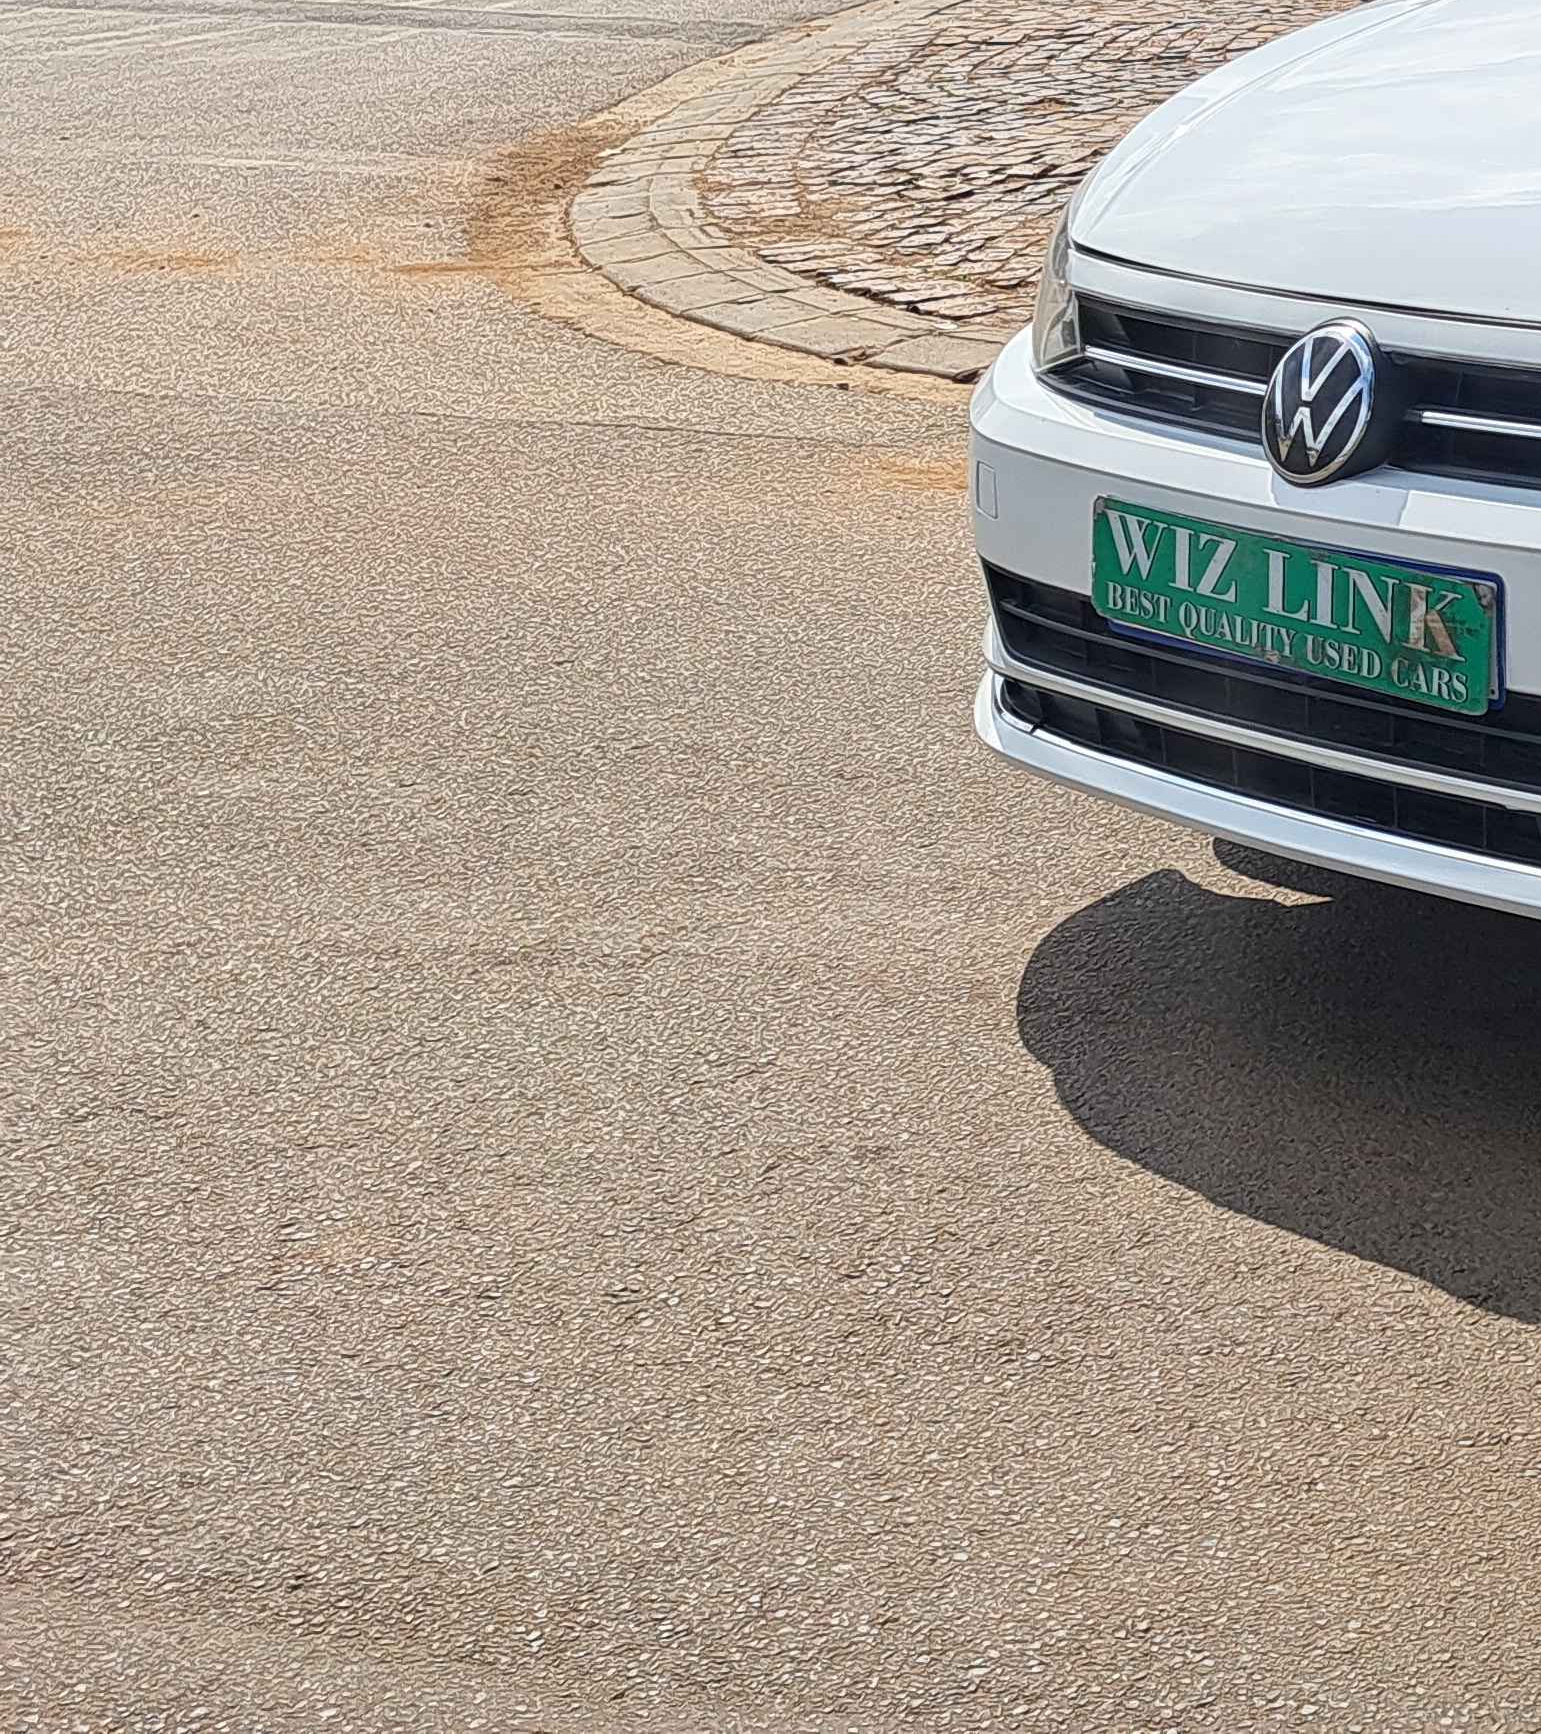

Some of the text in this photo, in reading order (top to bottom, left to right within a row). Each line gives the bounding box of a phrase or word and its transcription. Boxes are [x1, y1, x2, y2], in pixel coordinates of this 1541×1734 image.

[1105, 508, 1466, 663] WIZ LINK
[1105, 581, 1468, 703] BEST QUALITY USED CARS
